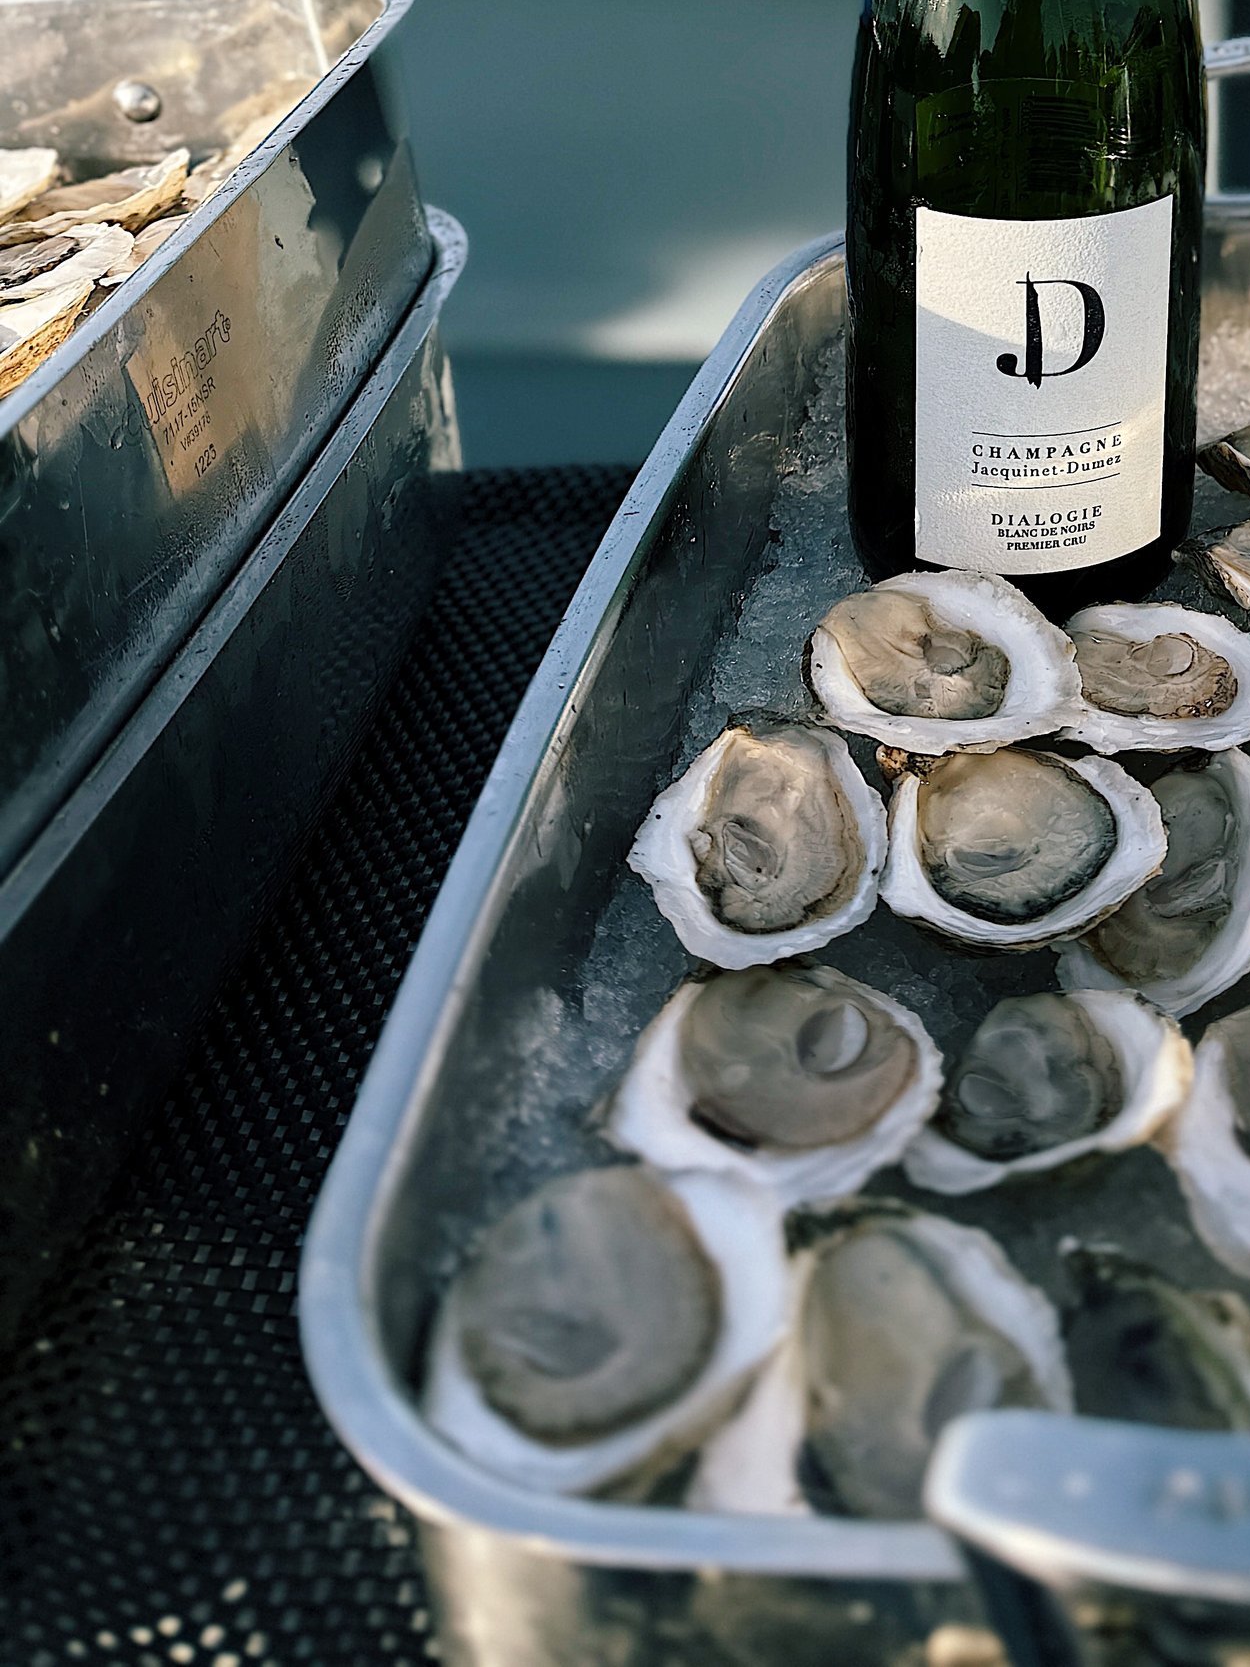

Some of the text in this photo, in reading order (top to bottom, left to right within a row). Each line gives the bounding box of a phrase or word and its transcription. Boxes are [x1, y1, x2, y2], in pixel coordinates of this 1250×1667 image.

[972, 434, 1122, 460] CHAMPAGNE
[971, 453, 1122, 481] Jacquinet-Dumez
[991, 505, 1103, 526] DIALOGIE
[997, 521, 1096, 538] BLANC DE NOIRS
[1006, 536, 1087, 551] PREMIER CRU
